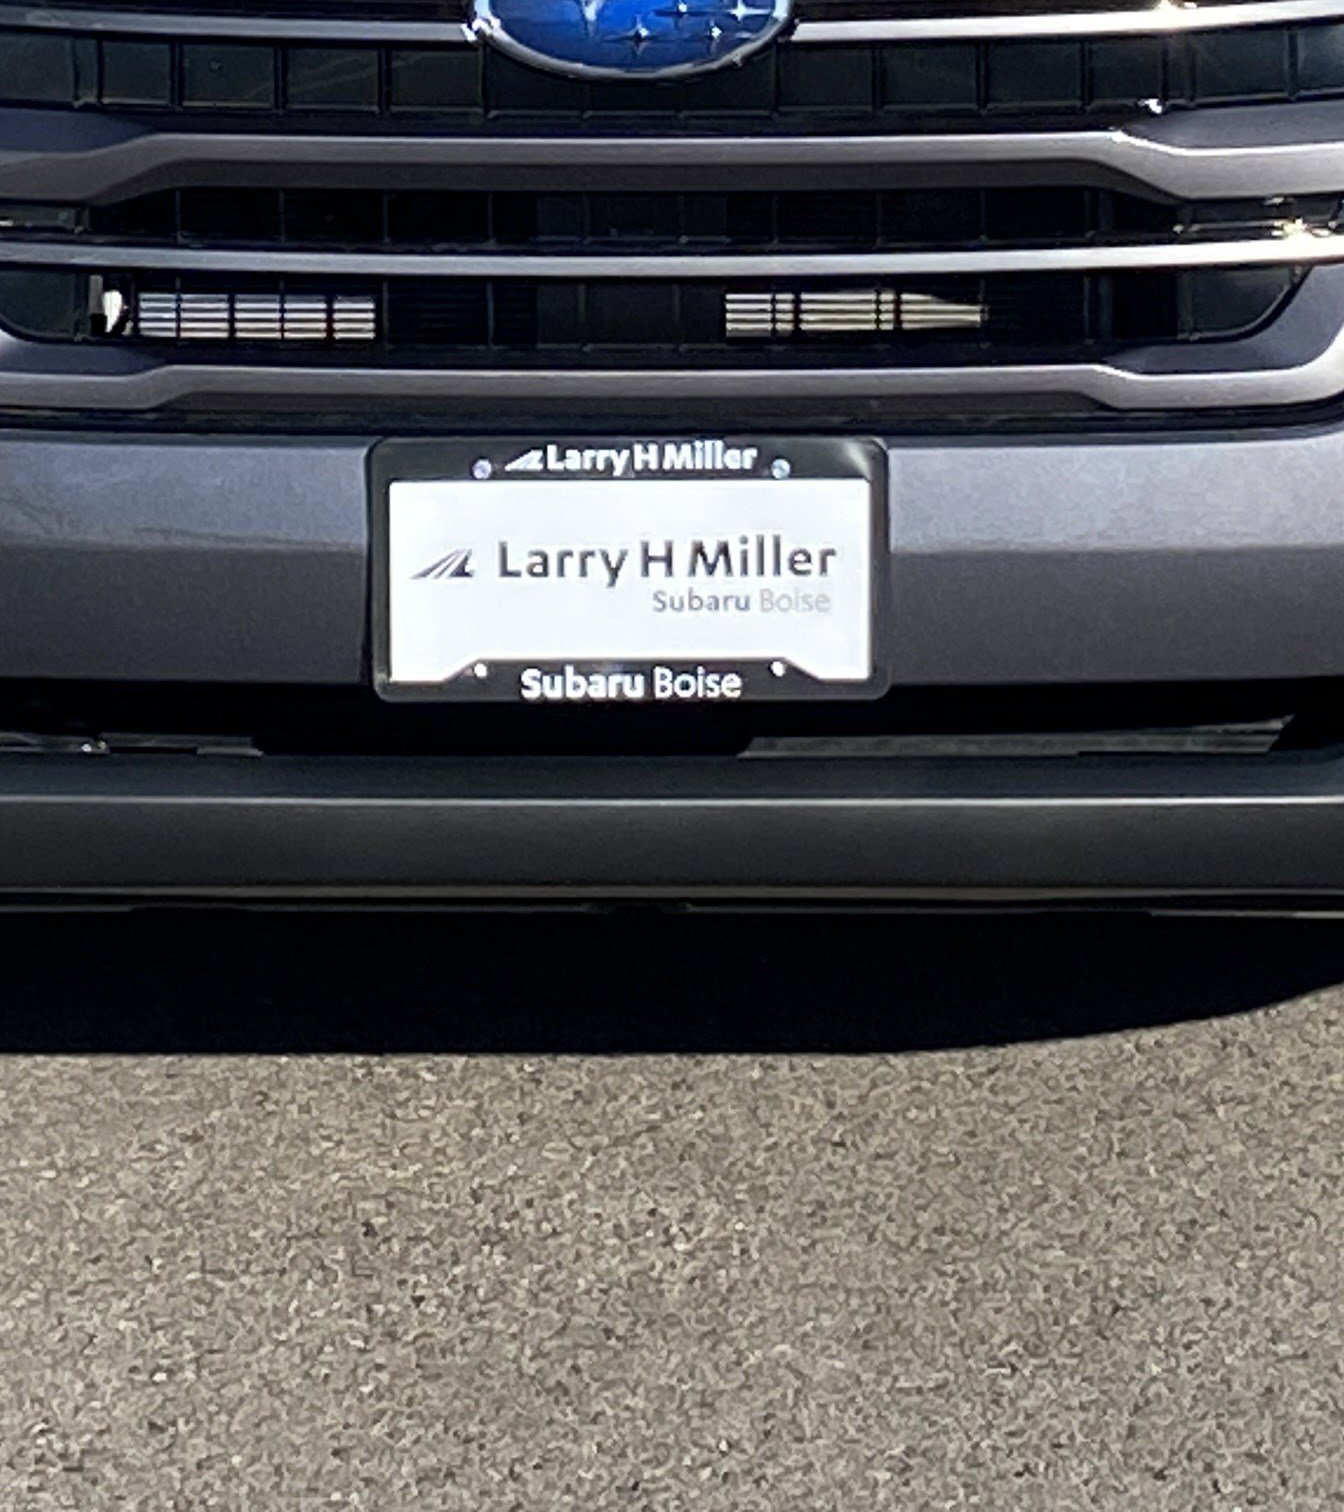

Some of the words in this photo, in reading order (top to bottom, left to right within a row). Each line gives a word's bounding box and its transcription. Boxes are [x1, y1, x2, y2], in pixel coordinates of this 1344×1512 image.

[547, 443, 631, 477] Larry
[634, 442, 658, 471] H
[662, 439, 758, 471] Miller
[498, 540, 629, 589] Larry
[640, 540, 674, 578] H
[686, 534, 837, 578] Miller
[652, 586, 751, 613] Subaru
[759, 587, 832, 613] Boise
[520, 664, 645, 700] Subaru
[653, 665, 743, 700] Boise
